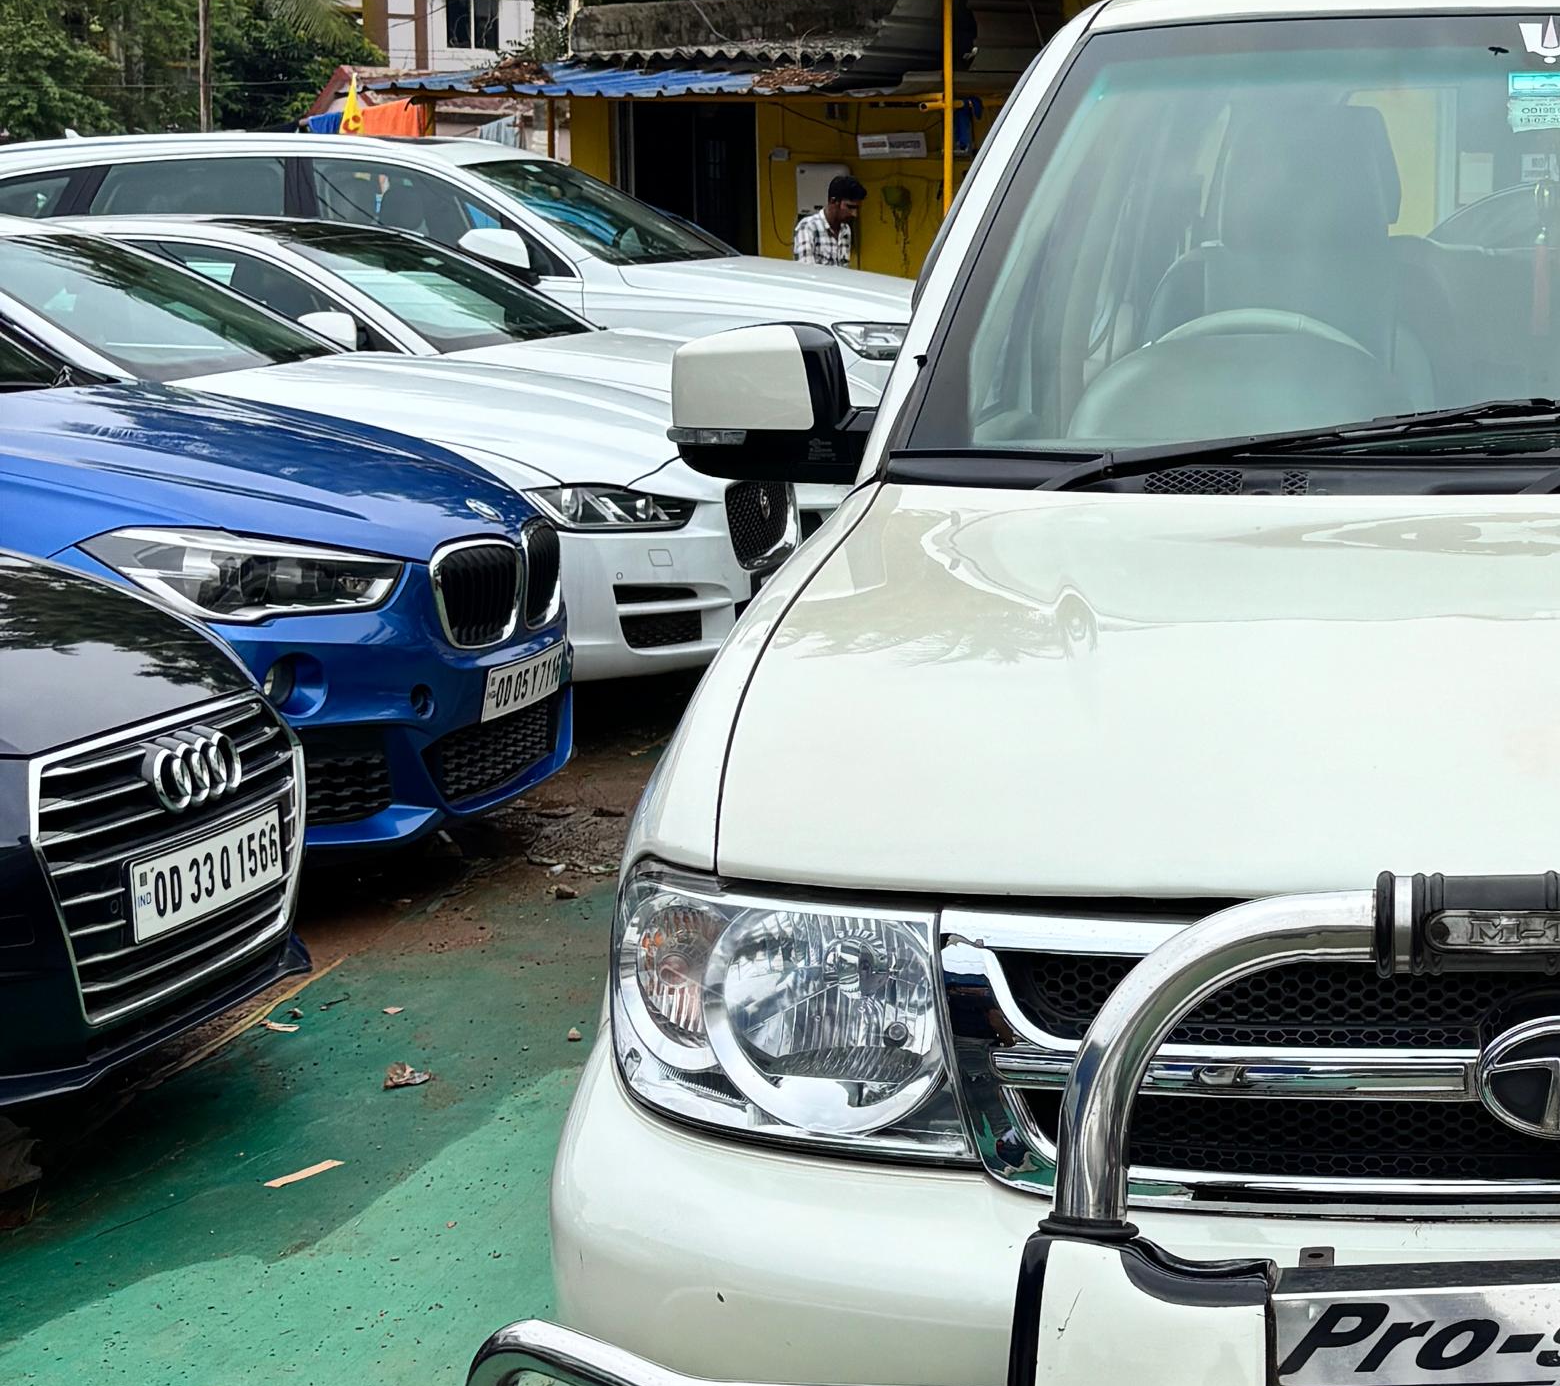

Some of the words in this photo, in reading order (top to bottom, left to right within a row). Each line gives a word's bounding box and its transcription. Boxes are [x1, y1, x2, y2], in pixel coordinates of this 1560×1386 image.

[188, 852, 216, 904] 33
[237, 823, 278, 883] 1566
[137, 891, 152, 908] IND
